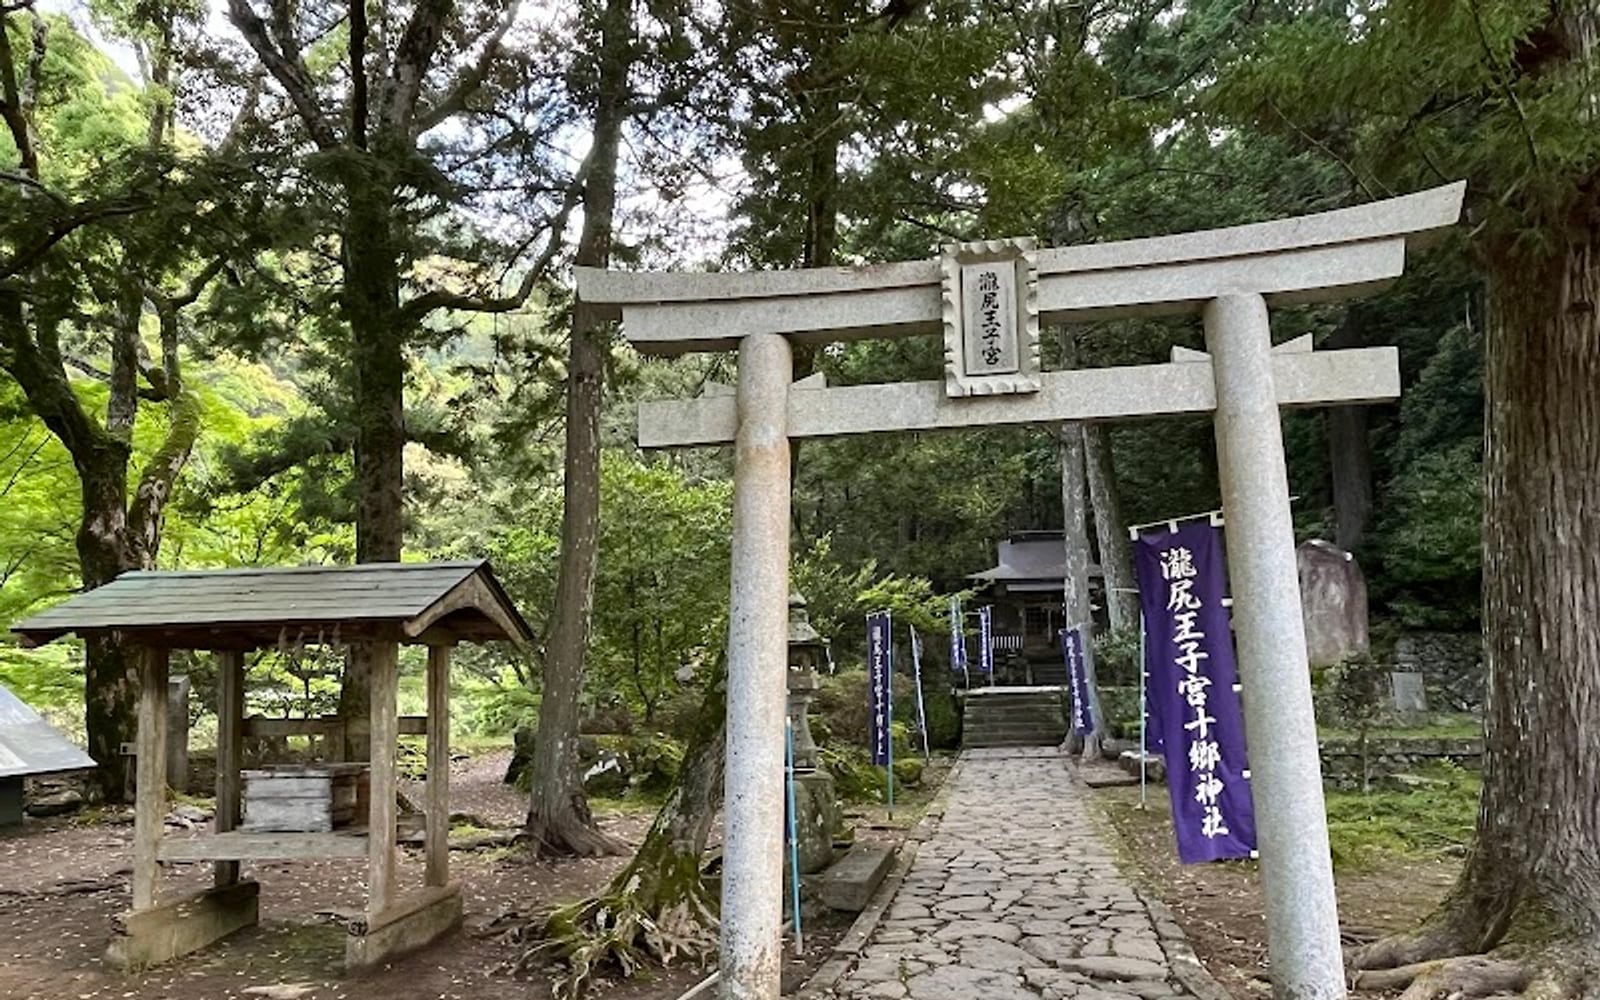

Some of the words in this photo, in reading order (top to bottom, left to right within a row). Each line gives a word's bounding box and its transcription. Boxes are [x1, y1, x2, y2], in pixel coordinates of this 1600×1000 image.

[979, 271, 1002, 365] 瀧尻王子宮
[1159, 547, 1230, 839] 瀧尻王子宮十郷神社
